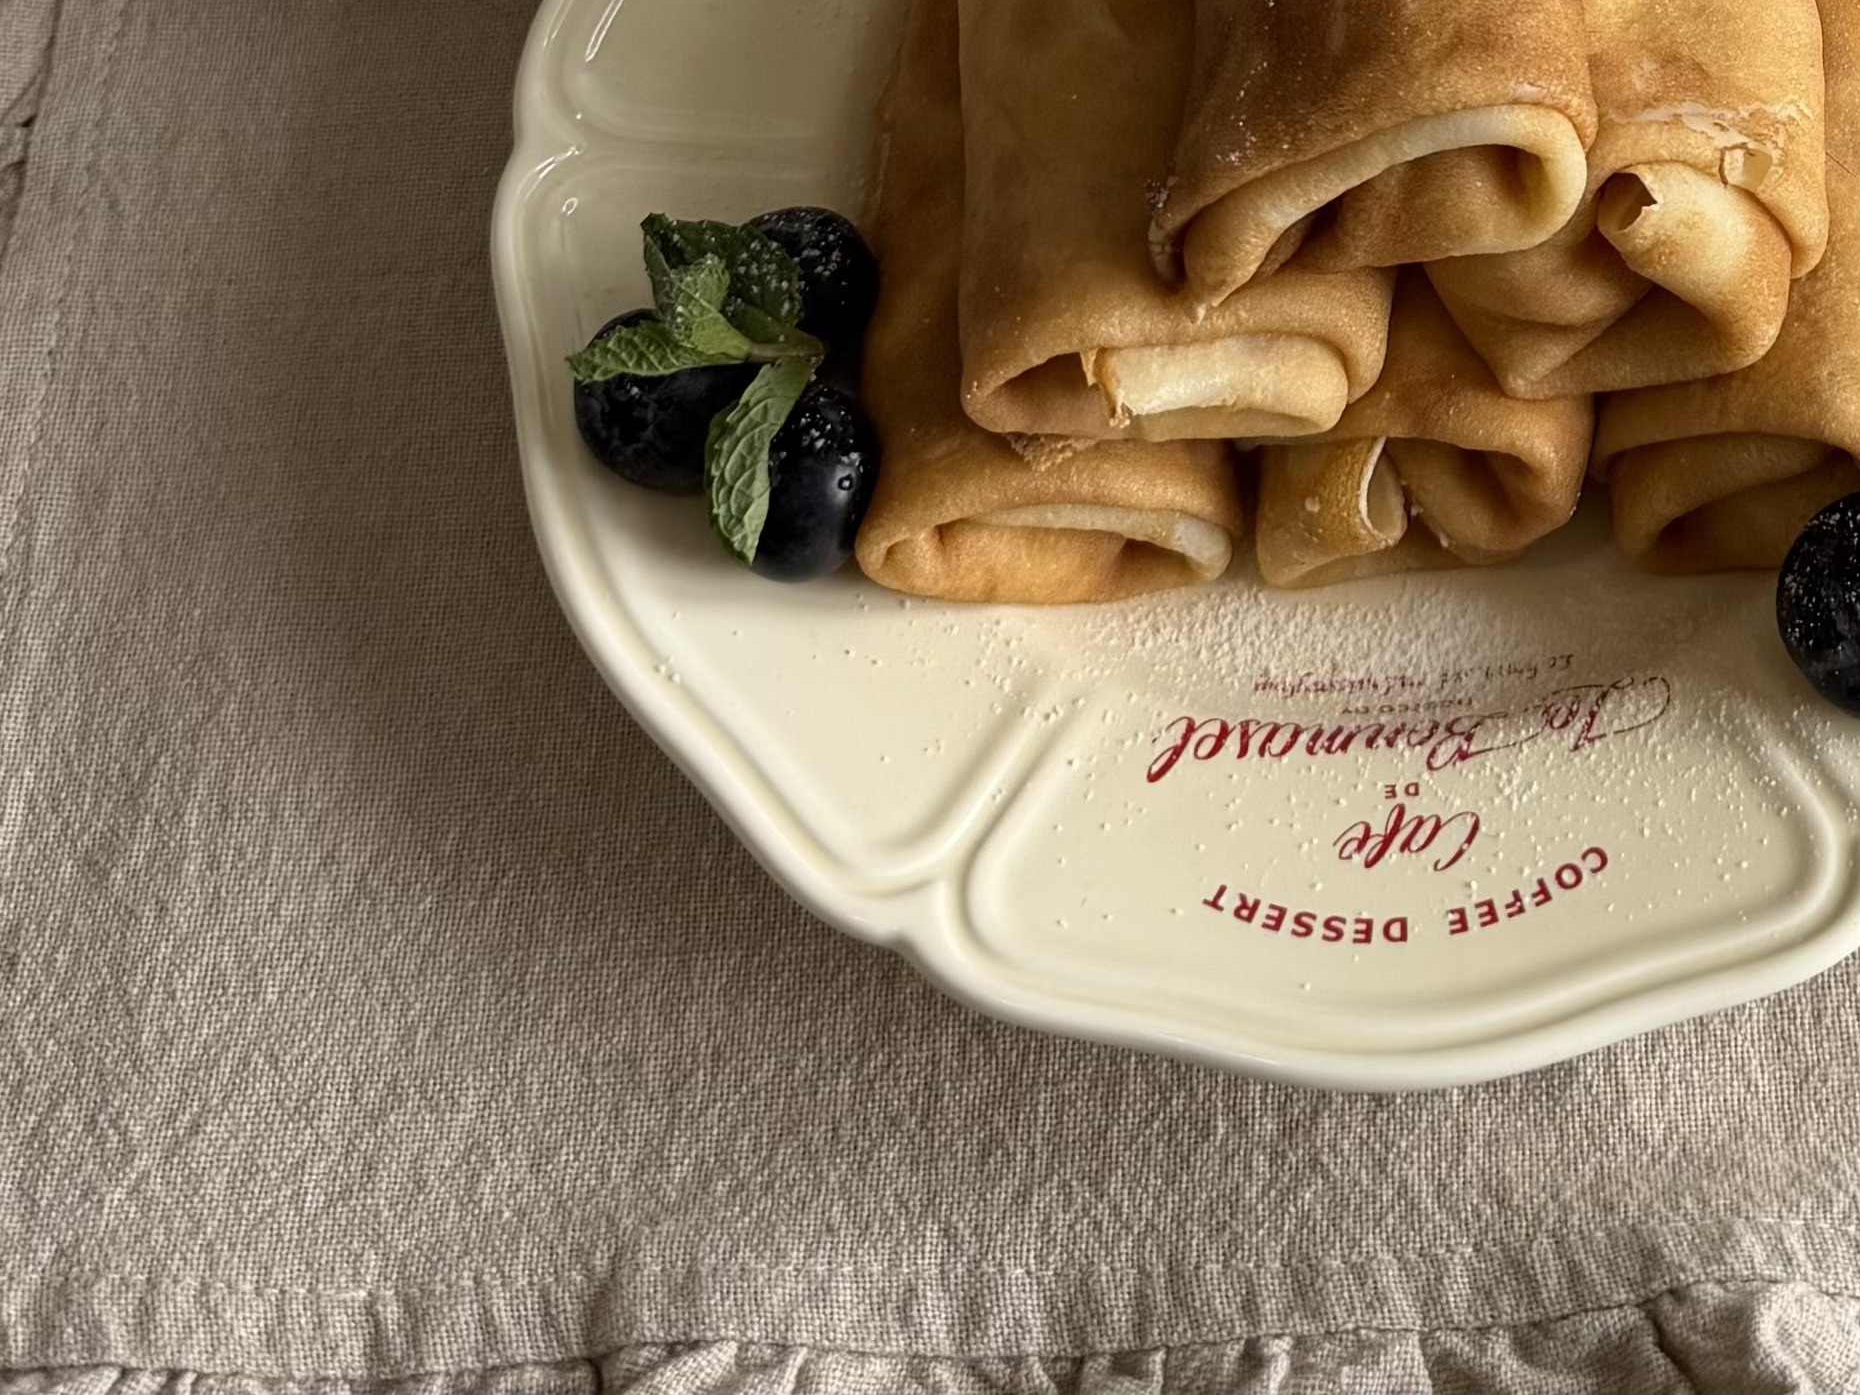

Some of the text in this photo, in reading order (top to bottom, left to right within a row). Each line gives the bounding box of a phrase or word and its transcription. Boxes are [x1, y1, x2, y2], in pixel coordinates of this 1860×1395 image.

[1384, 781, 1420, 800] DE
[1332, 803, 1482, 872] Cafe
[1202, 847, 1609, 944] COFFEE DESSERT
